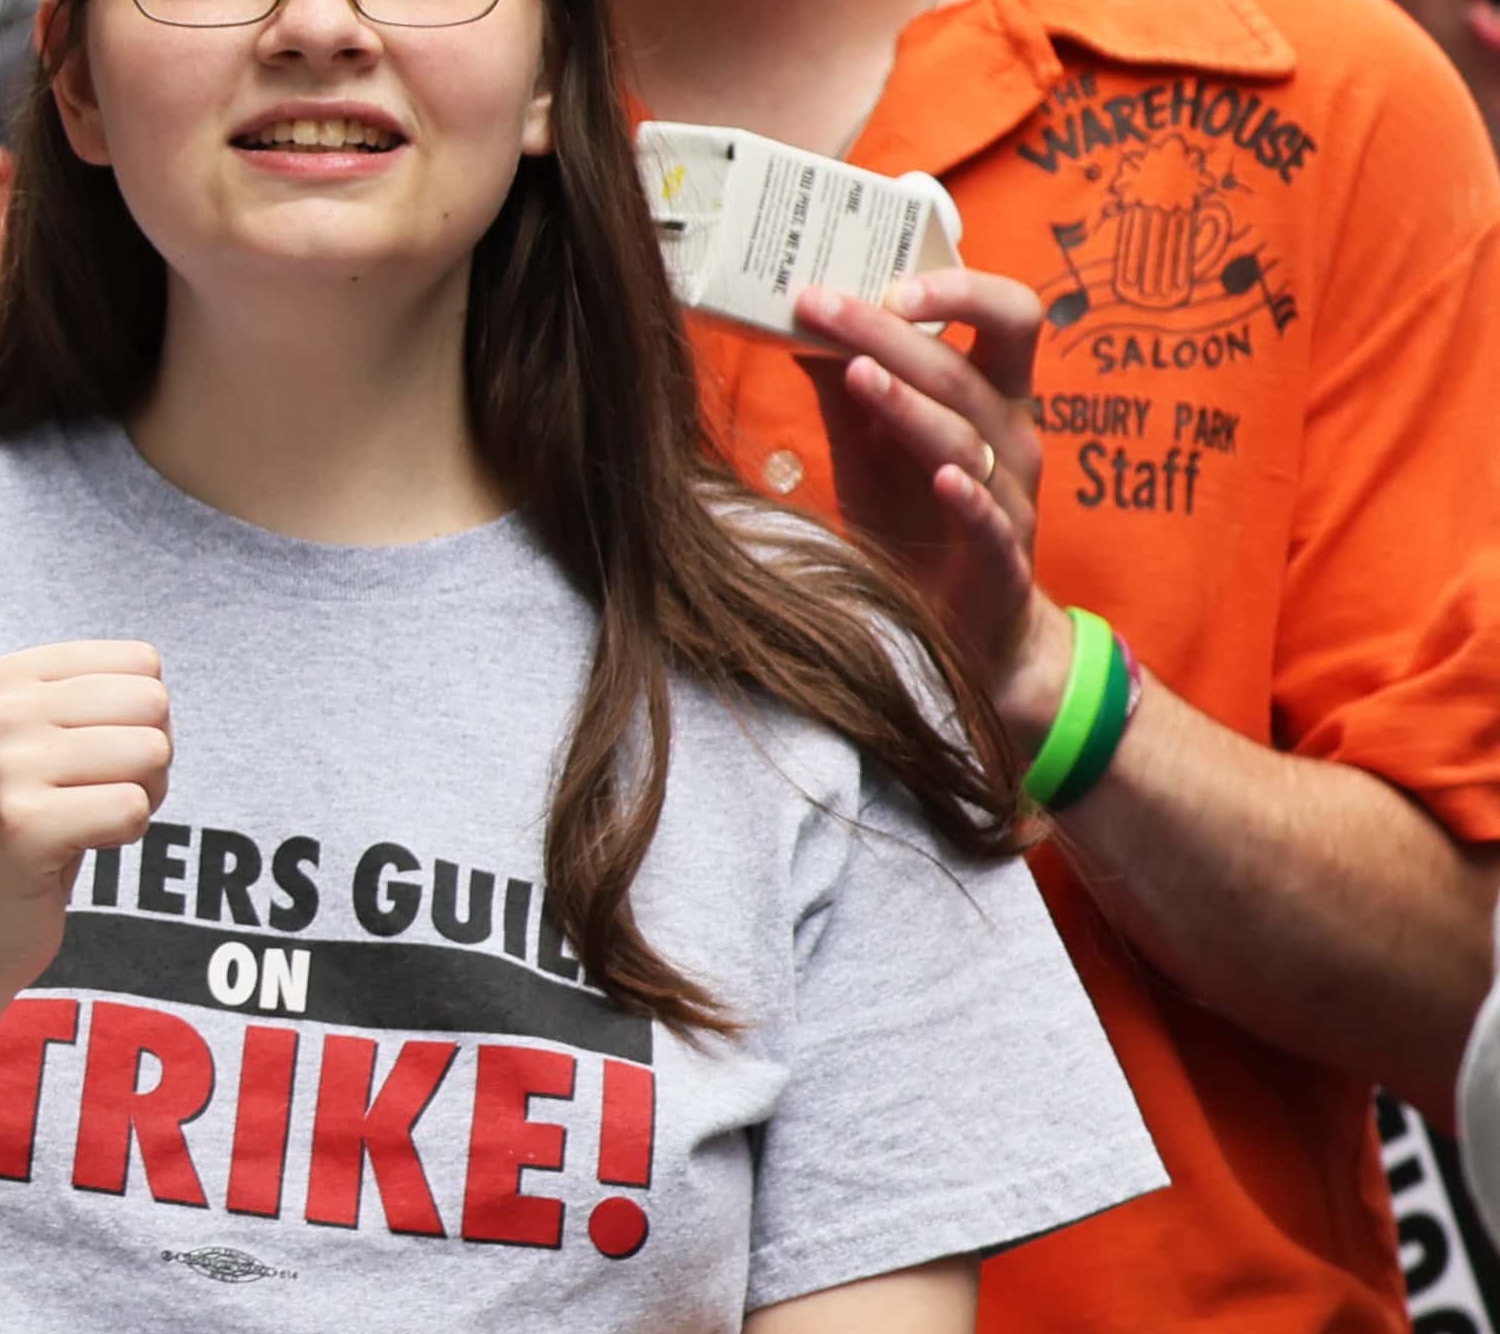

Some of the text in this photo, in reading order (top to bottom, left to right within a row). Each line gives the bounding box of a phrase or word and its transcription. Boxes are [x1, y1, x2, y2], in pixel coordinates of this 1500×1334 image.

[1016, 78, 1318, 185] WAREHOUSE
[1091, 323, 1254, 374] SALOON
[1032, 392, 1240, 455] ASBURY PARK
[1075, 440, 1202, 516] Staff
[352, 841, 586, 984] GUIL
[206, 940, 311, 1014] ON
